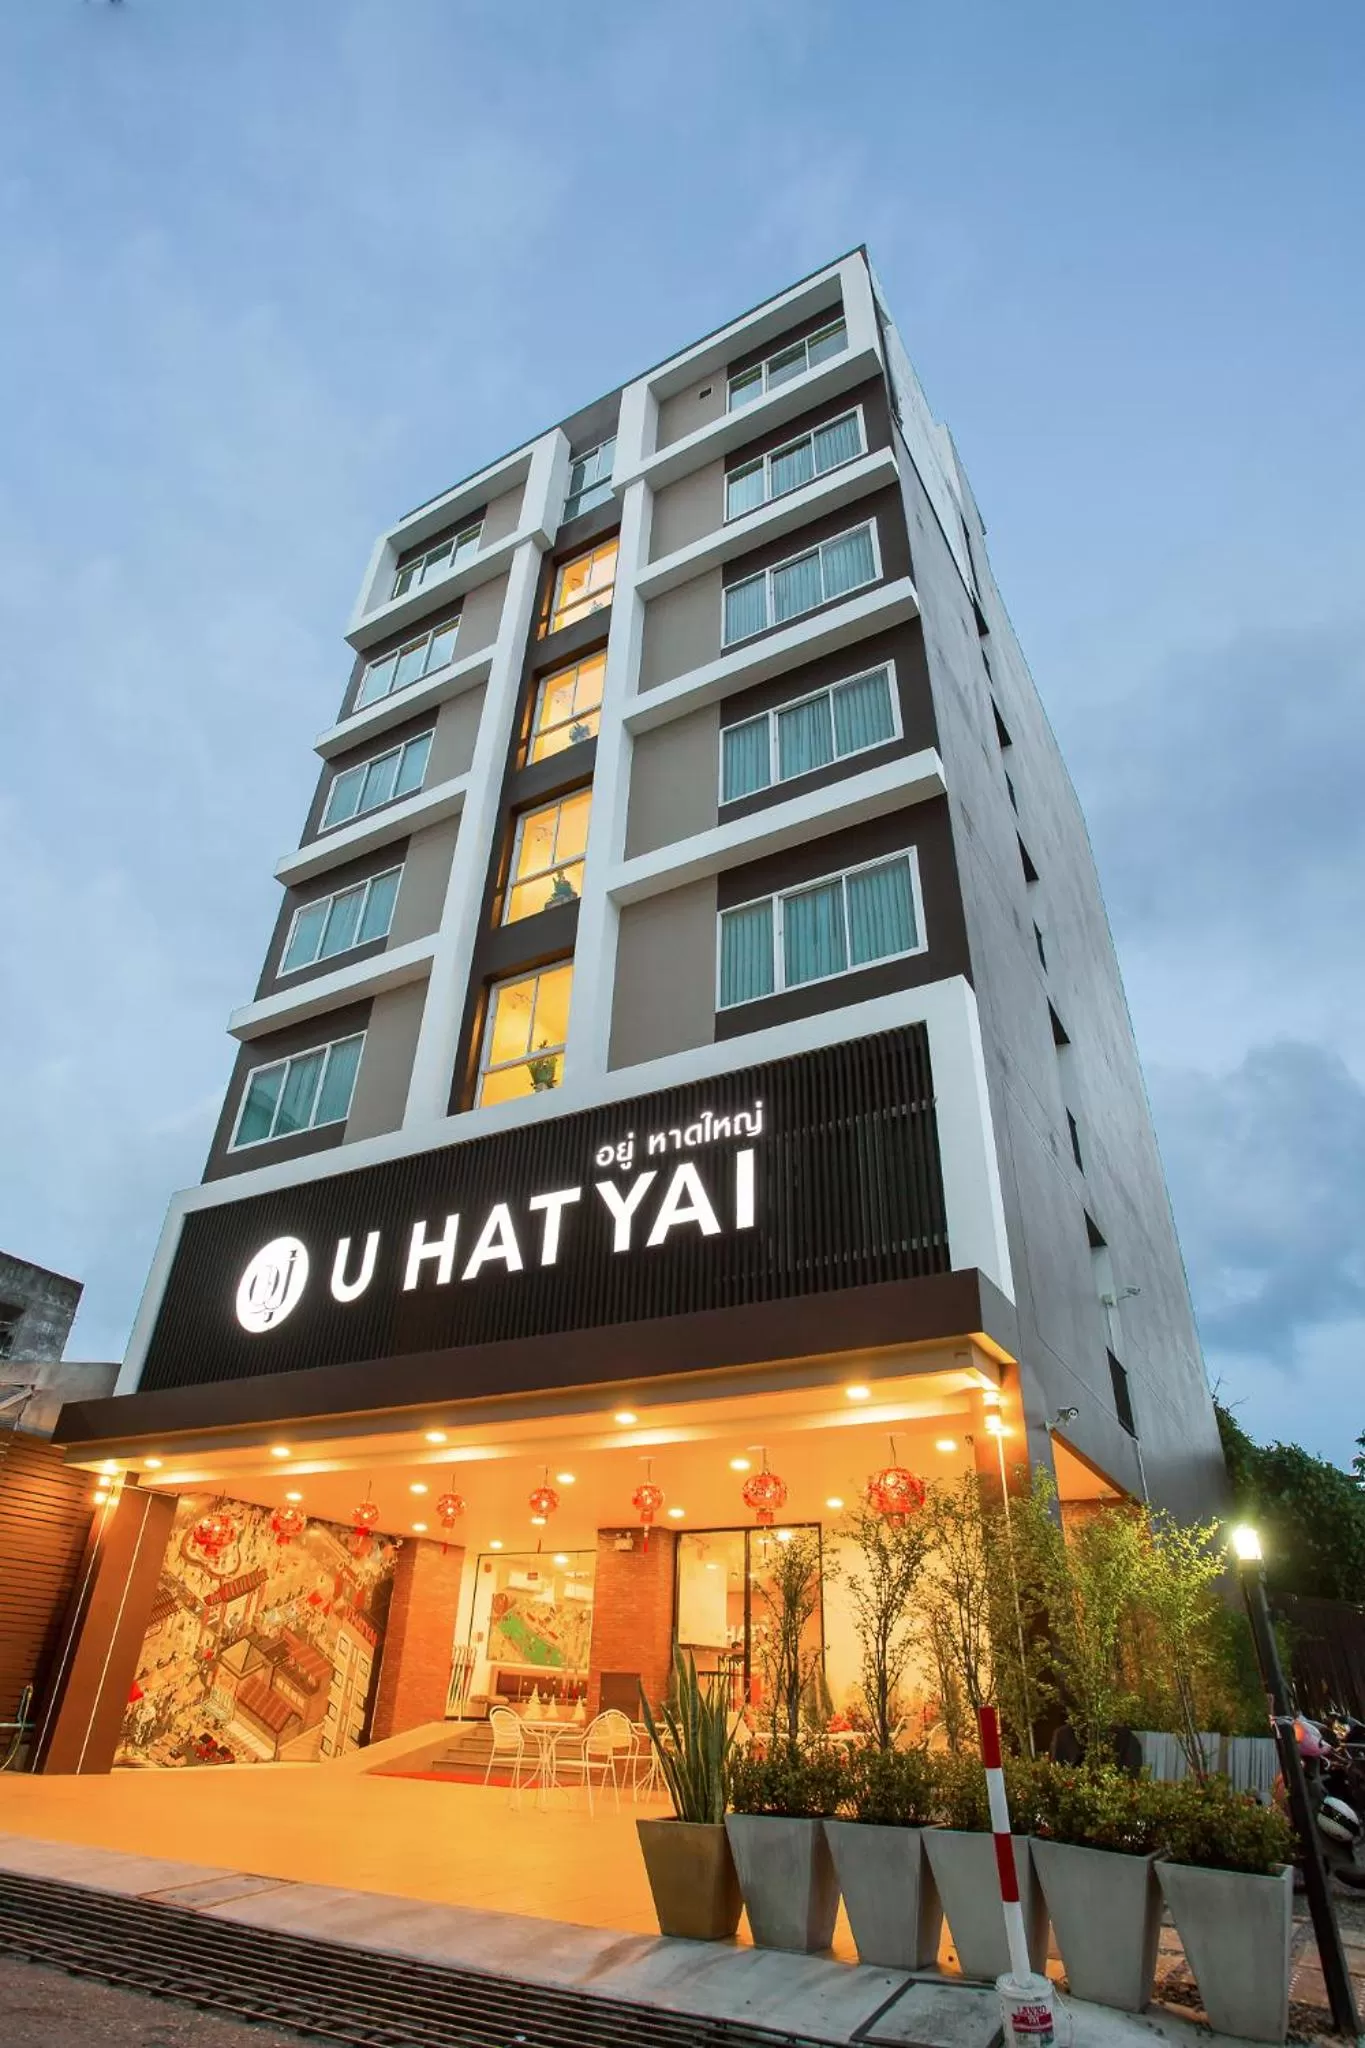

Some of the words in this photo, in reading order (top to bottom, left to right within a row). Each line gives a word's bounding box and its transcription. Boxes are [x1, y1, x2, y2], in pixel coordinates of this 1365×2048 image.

[595, 1131, 635, 1170] อยู่
[648, 1100, 764, 1156] หาดใหญ่
[330, 1230, 381, 1303] U
